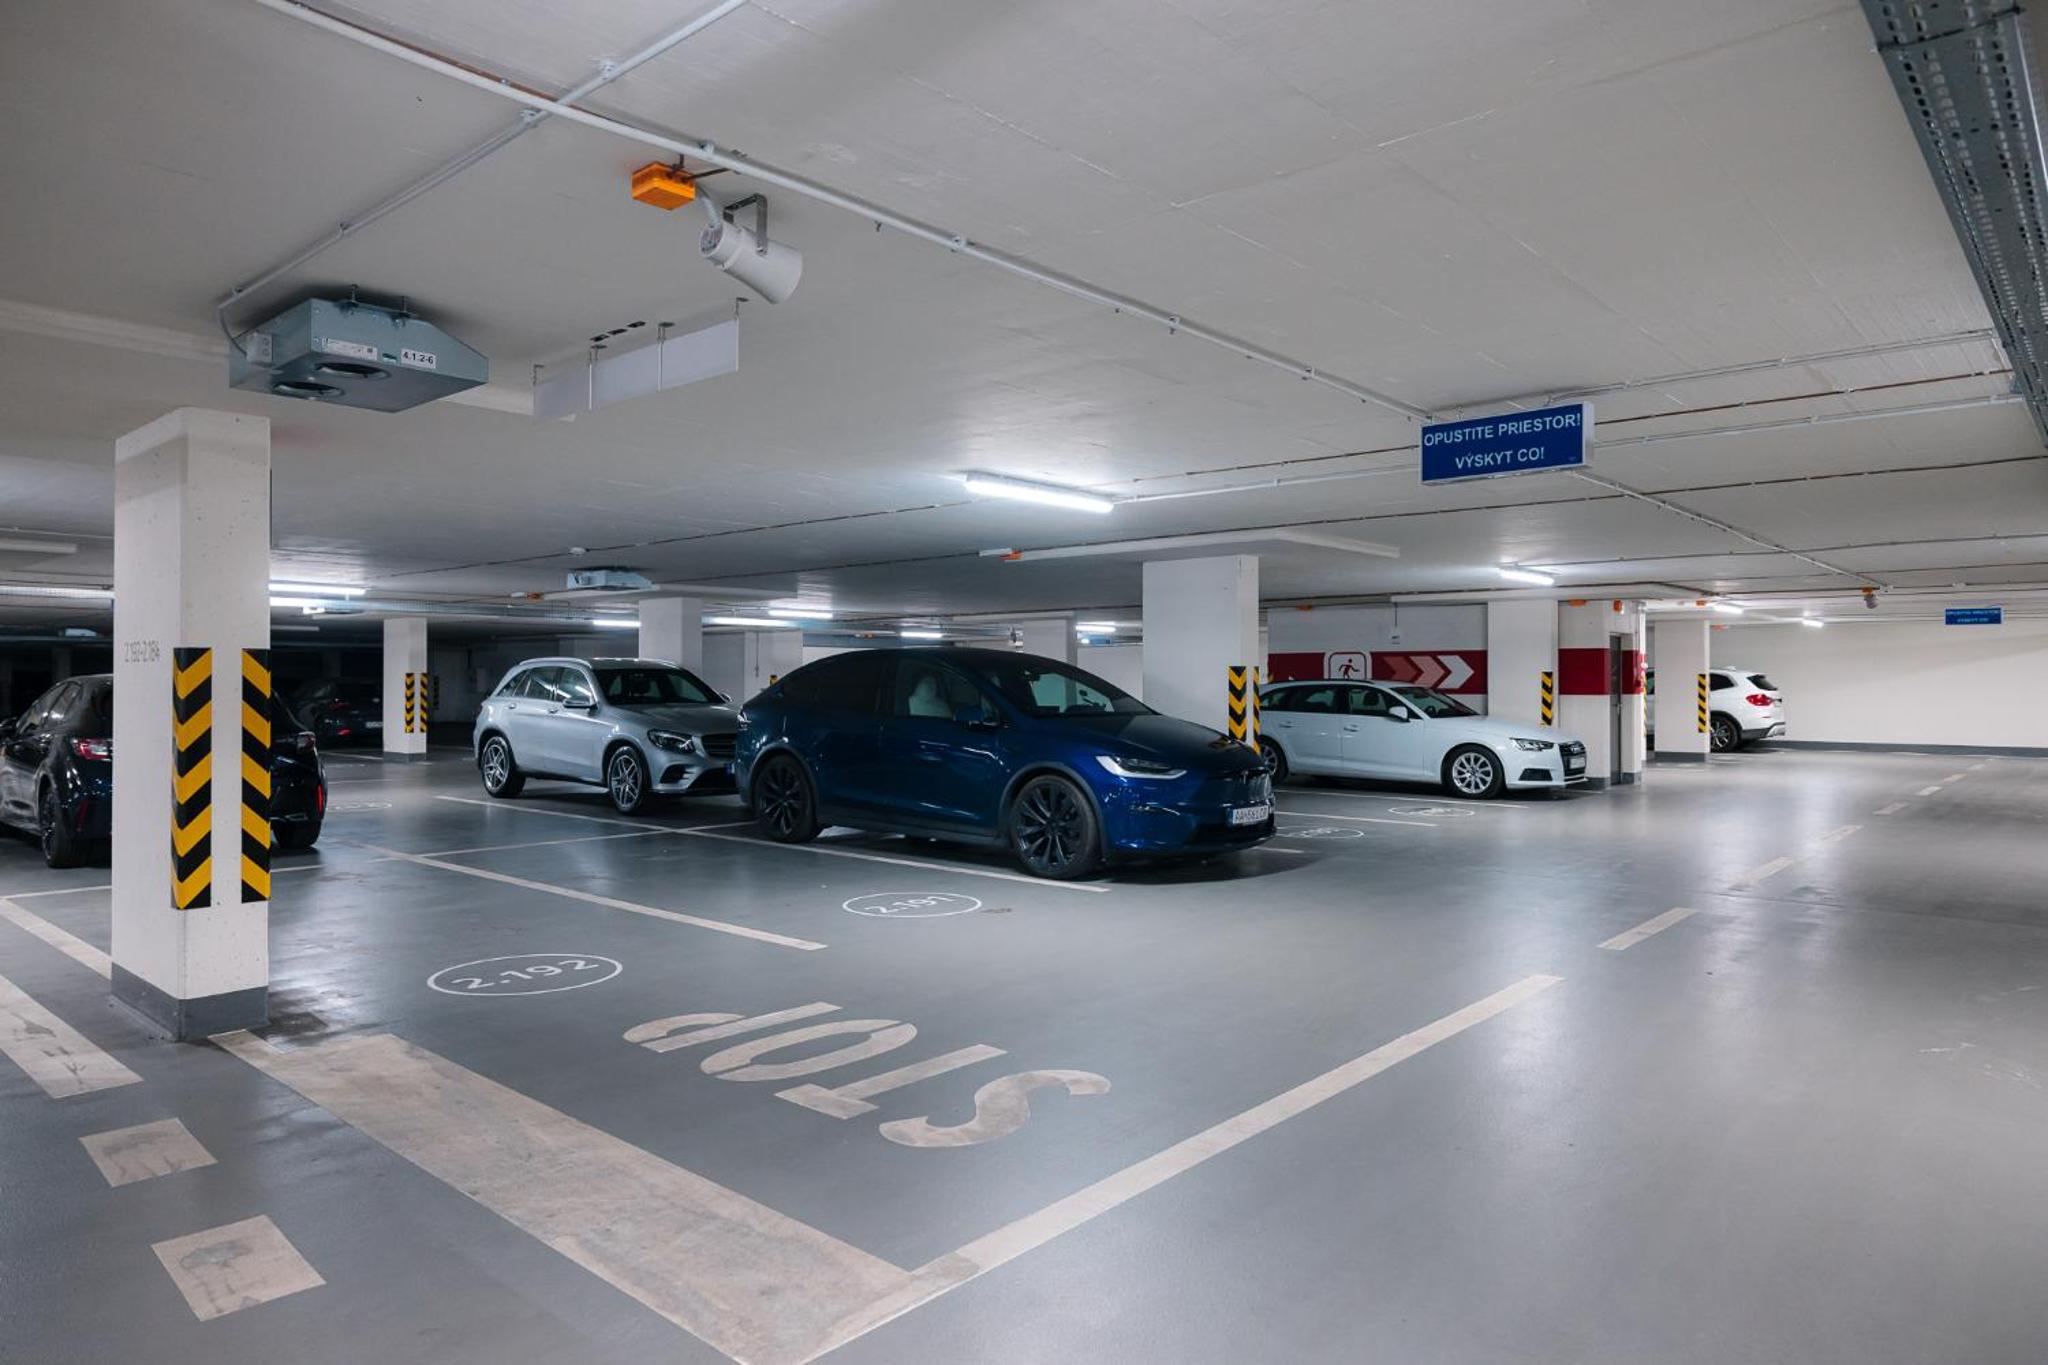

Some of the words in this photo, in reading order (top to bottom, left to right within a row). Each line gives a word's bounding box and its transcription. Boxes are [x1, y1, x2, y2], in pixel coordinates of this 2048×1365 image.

[1424, 425, 1495, 447] OPUSTITE
[1498, 412, 1582, 437] PRIESTOR!
[1517, 446, 1545, 463] CO!
[451, 959, 600, 990] 2.192
[622, 1001, 1112, 1148] STOP
